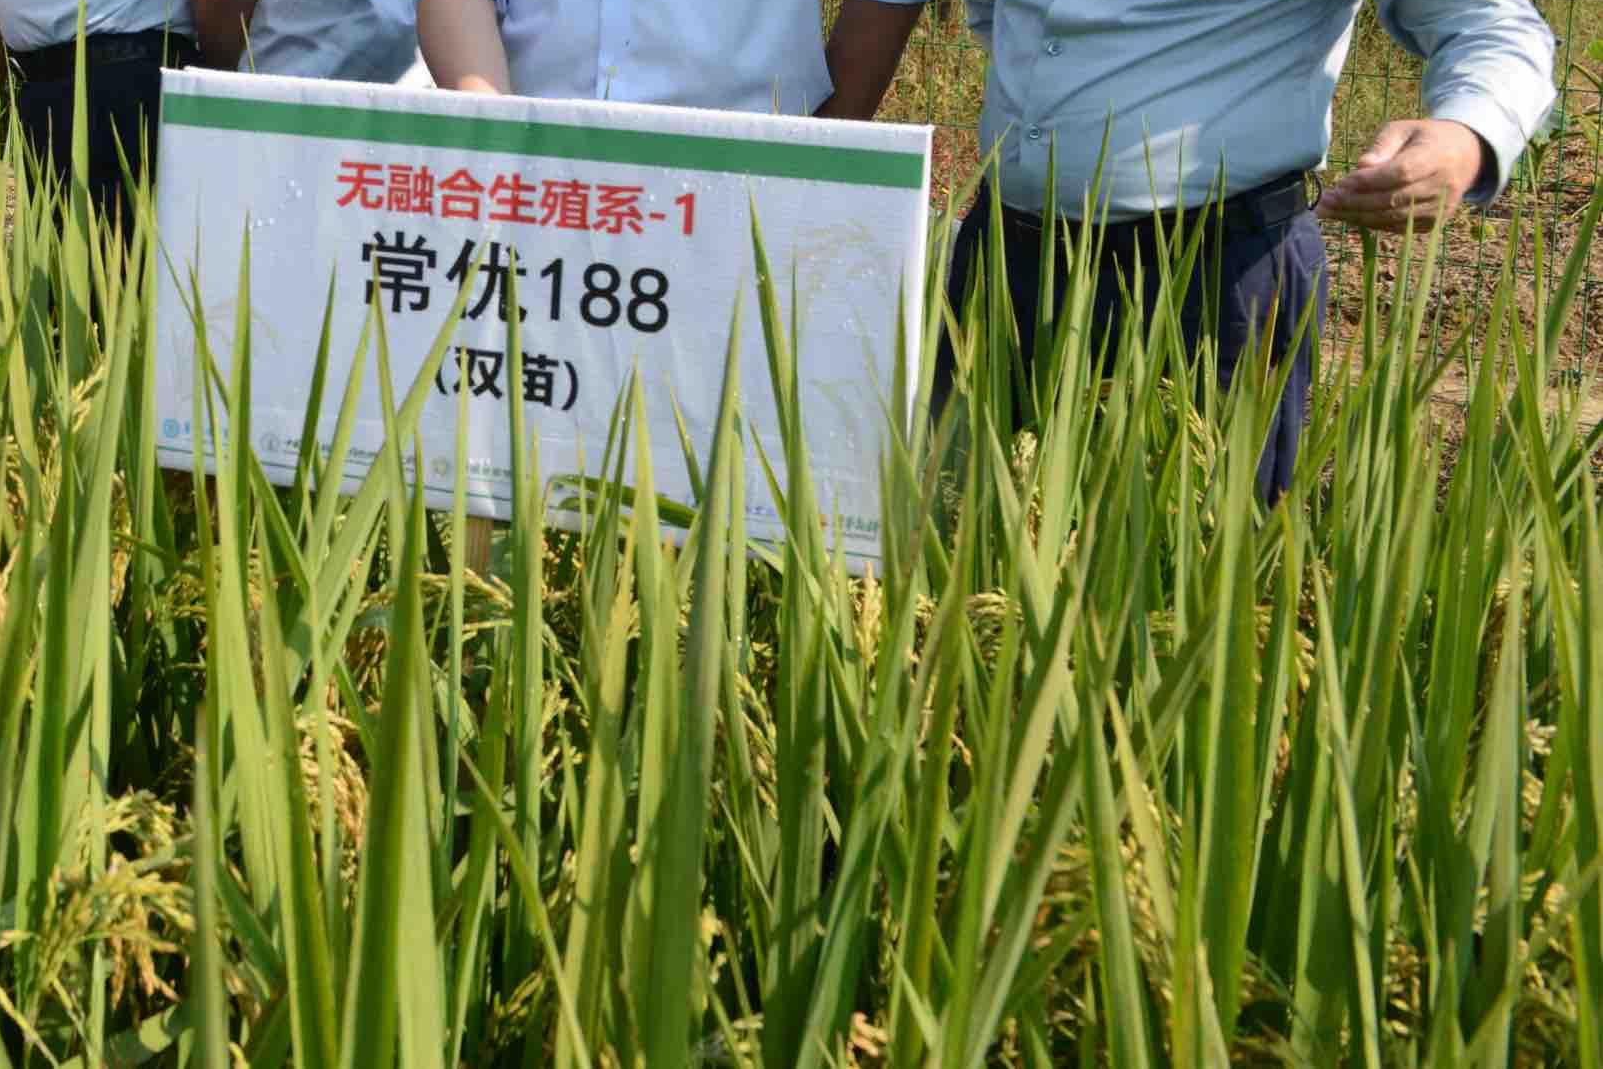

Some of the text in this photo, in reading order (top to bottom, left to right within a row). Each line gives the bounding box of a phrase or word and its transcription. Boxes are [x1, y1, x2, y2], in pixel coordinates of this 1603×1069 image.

[336, 161, 696, 235] 无融合生殖系-1
[361, 231, 670, 332] 常优188
